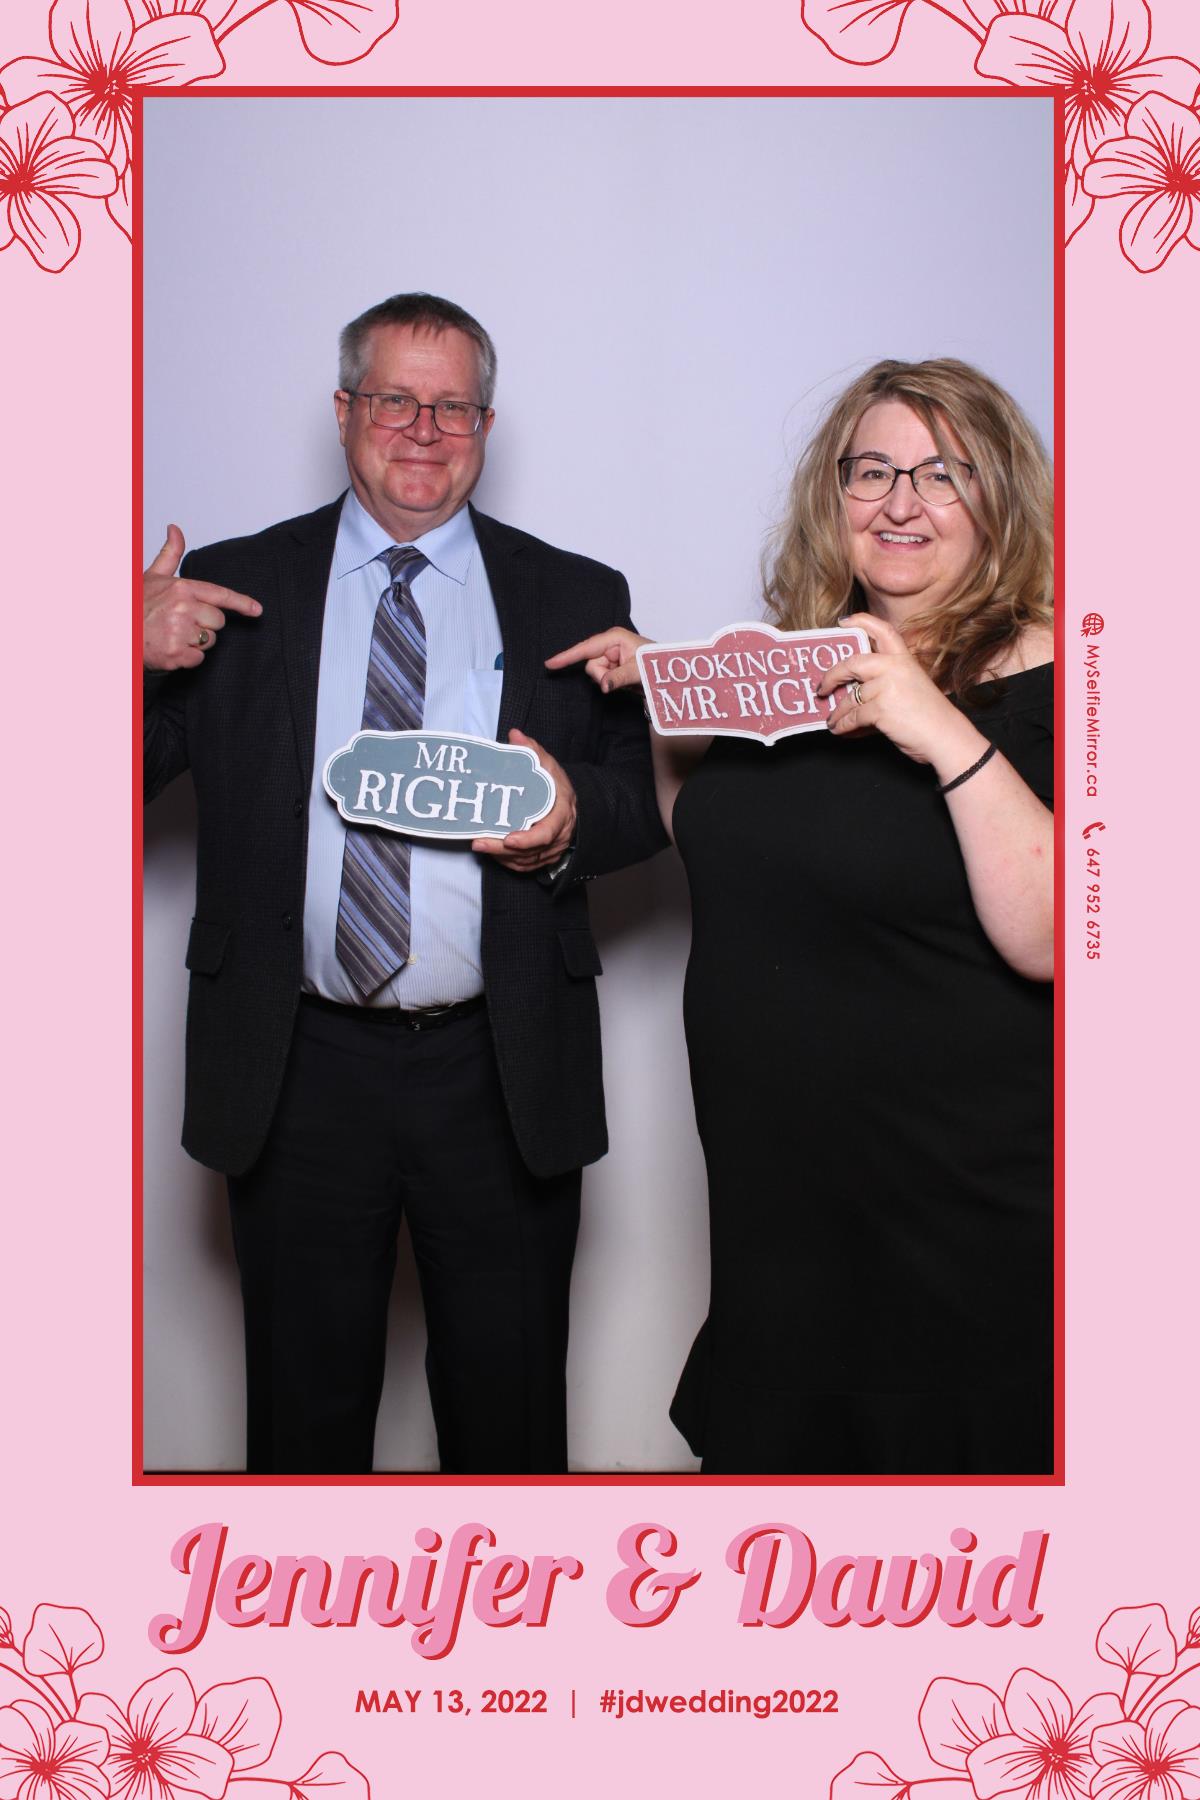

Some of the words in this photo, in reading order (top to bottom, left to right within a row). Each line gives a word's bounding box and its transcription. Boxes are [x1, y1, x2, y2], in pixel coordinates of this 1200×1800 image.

[650, 648, 790, 684] LOOKING
[656, 686, 729, 722] MR.
[733, 676, 854, 718] RIGH
[413, 741, 472, 774] MR.
[353, 769, 525, 827] RIGHT
